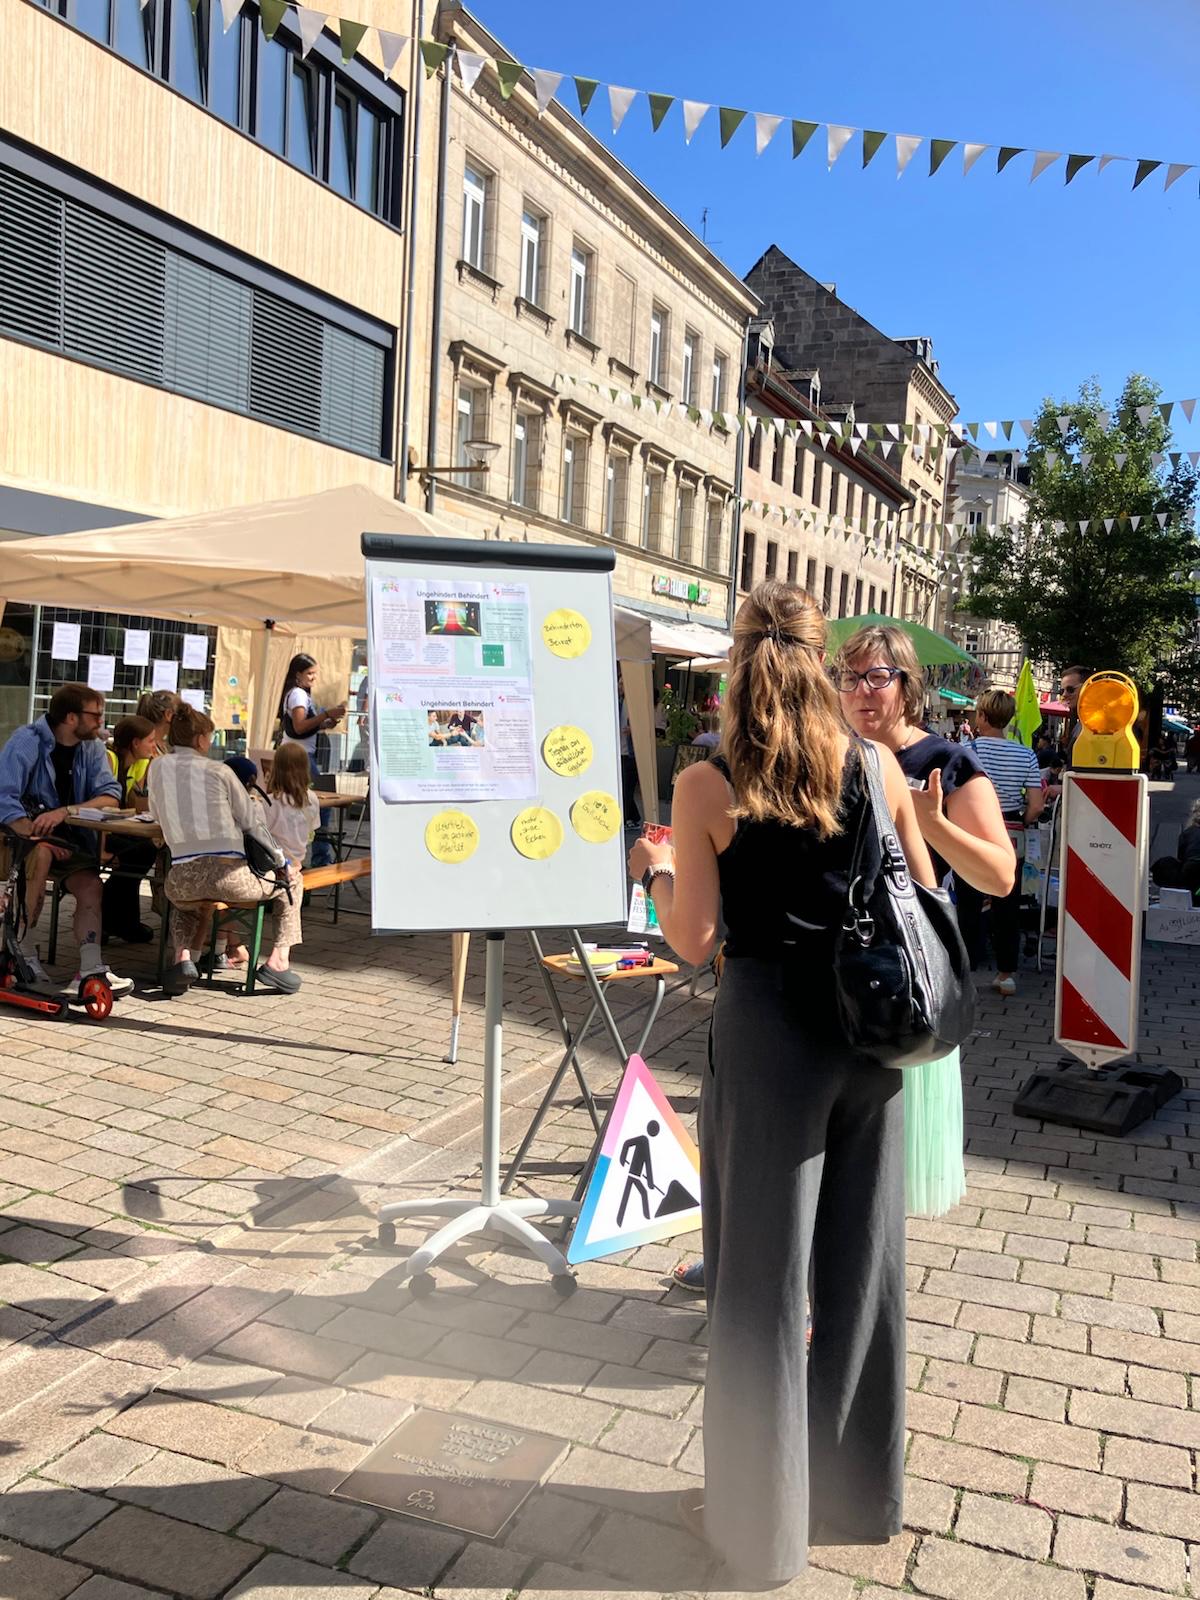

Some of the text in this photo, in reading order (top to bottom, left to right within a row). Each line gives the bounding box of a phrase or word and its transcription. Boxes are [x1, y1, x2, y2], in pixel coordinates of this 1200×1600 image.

[416, 590, 457, 601] Ungehindert
[457, 591, 489, 601] Behindert
[420, 699, 494, 709] Ungehindert Behindert
